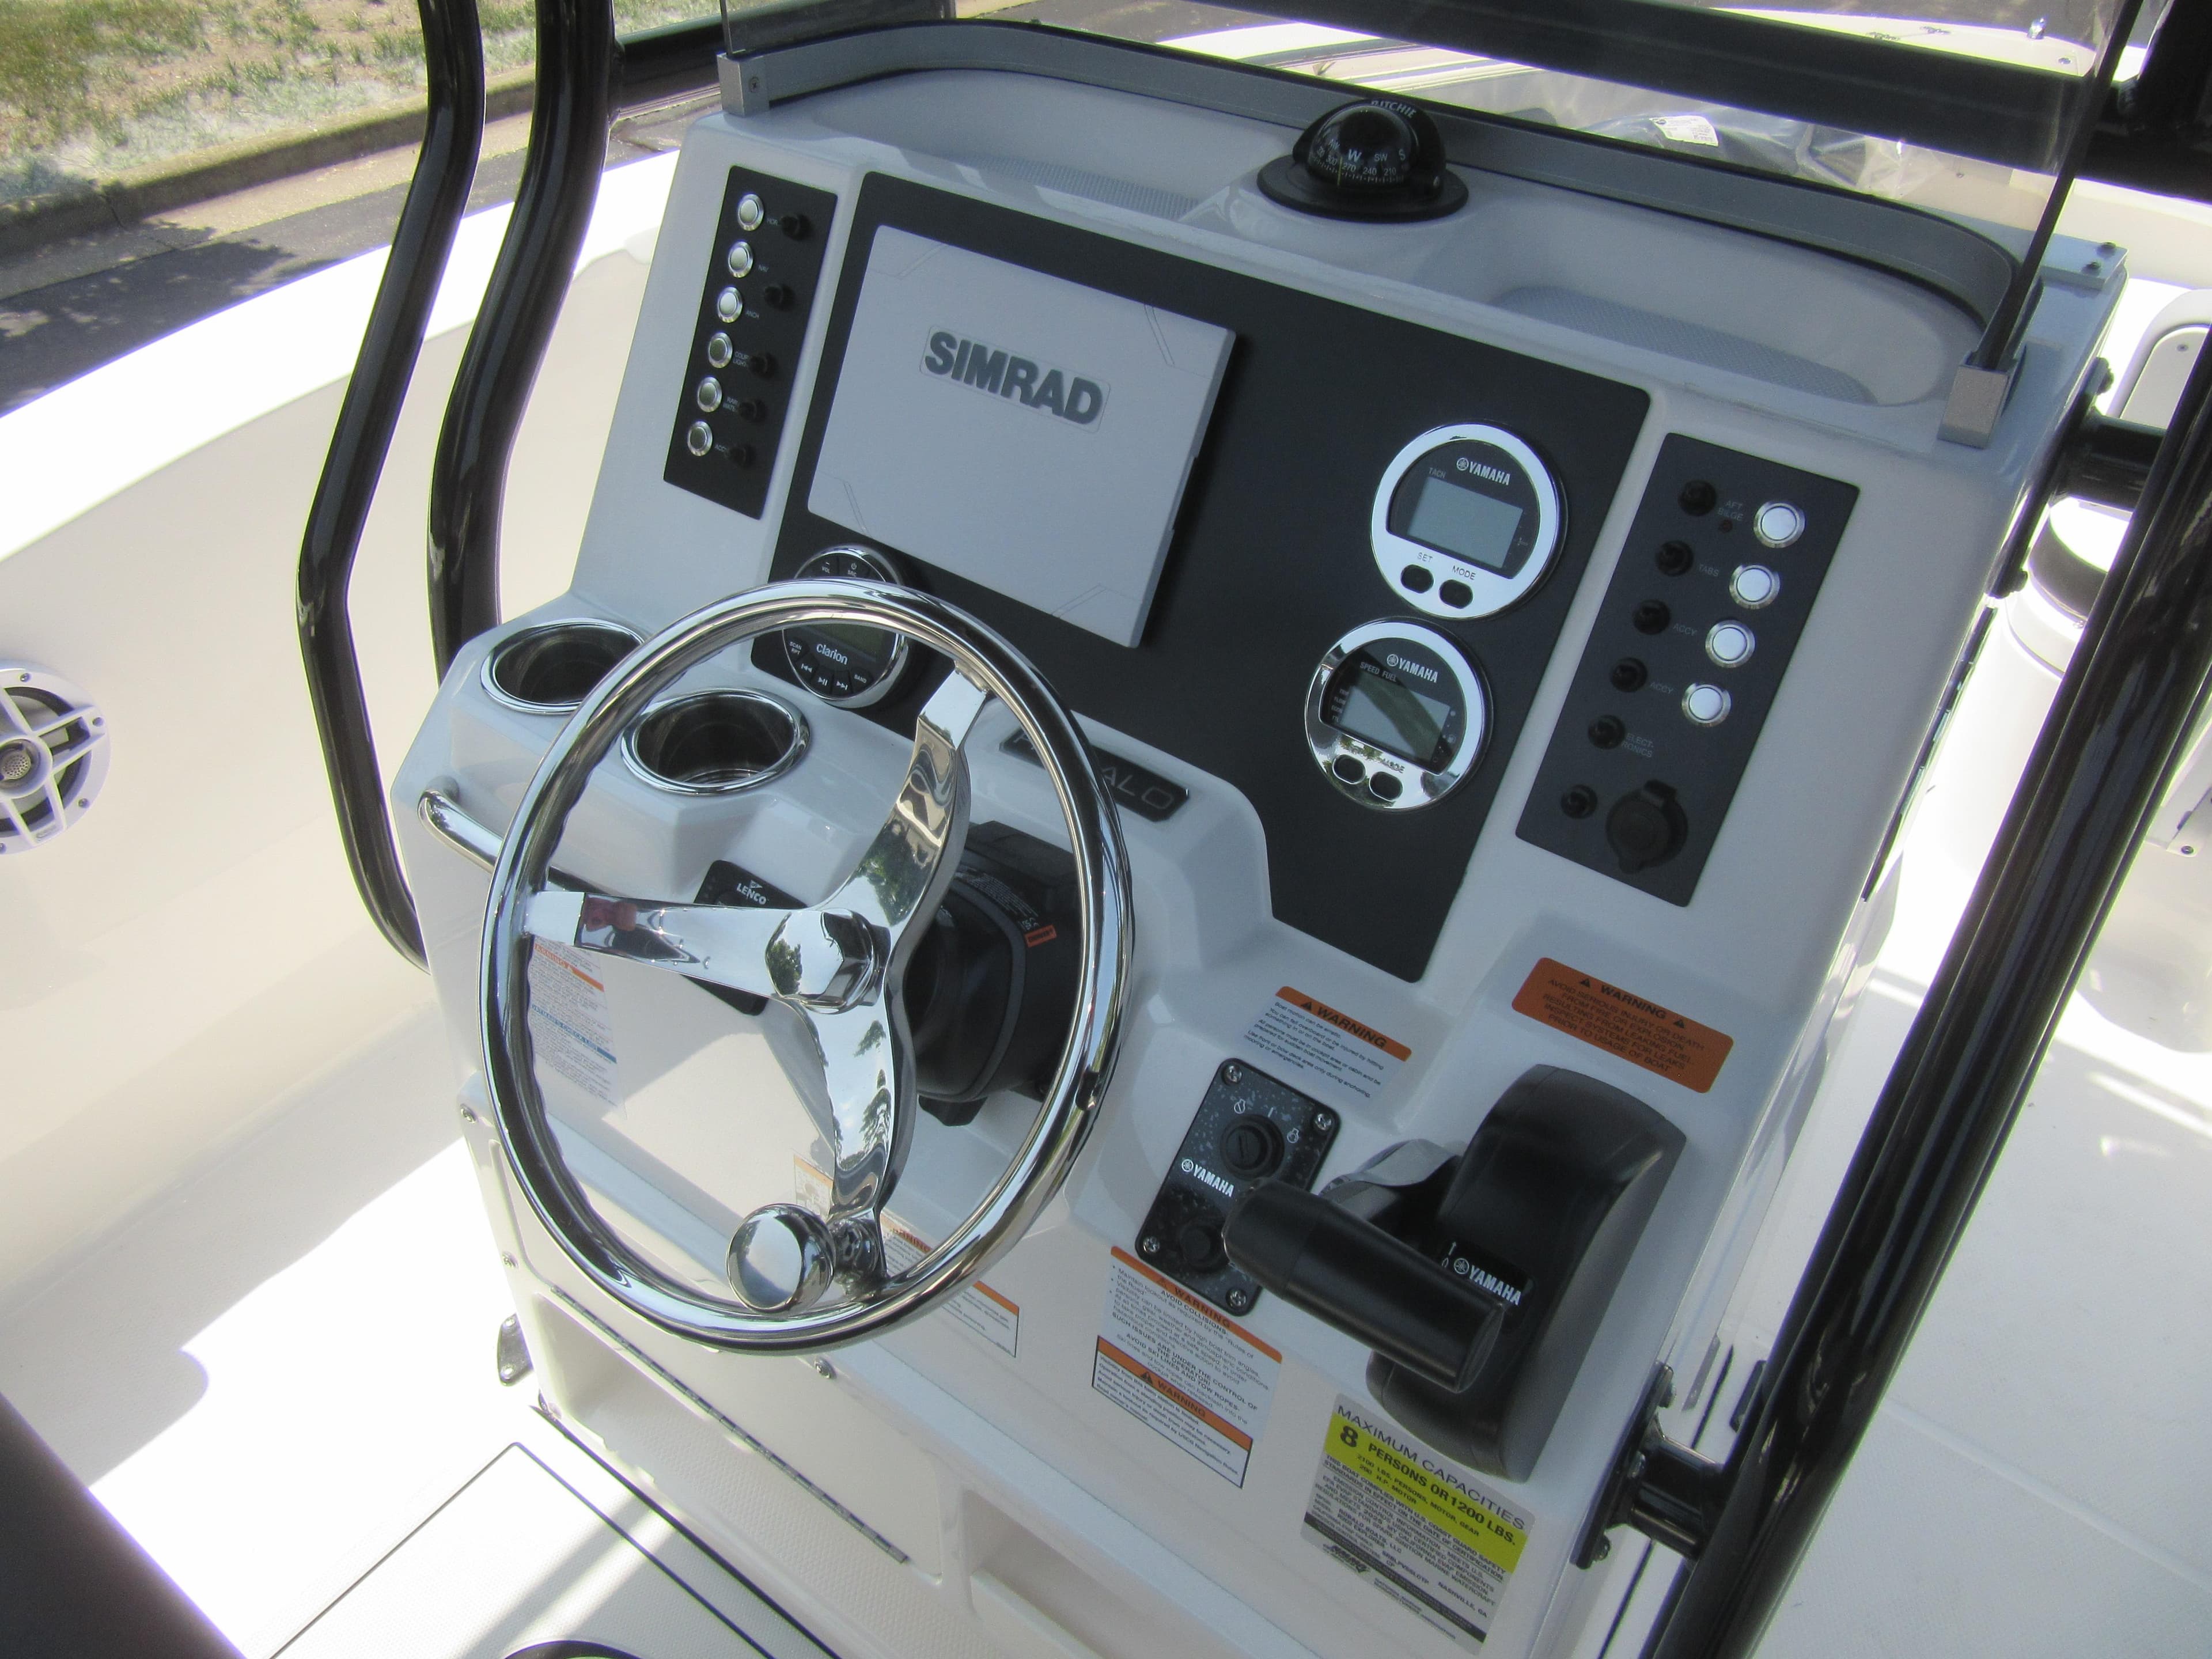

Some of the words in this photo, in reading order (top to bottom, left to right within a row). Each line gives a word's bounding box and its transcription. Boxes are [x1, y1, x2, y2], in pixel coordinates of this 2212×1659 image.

[1342, 162, 1356, 172] 270
[1363, 167, 1377, 176] 240
[1384, 168, 1397, 176] 210
[1348, 149, 1362, 162] W
[1399, 149, 1406, 161] S
[925, 331, 1103, 425] SIMRAD
[1429, 467, 1446, 478] TACH
[1468, 461, 1511, 486] YAMAHA
[1417, 552, 1434, 563] SET
[1452, 565, 1476, 581] MODE
[816, 643, 849, 665] clarion
[1360, 662, 1380, 675] SPEED
[1382, 670, 1398, 683] FUEL
[1398, 657, 1439, 684] YAMAHA
[736, 882, 767, 905] LENCO
[1598, 984, 1668, 1020] WARNING
[1315, 1006, 1389, 1048] WARNING
[1193, 1164, 1235, 1198] YAMAHA
[1161, 1288, 1182, 1307] AVOID
[1469, 1264, 1522, 1306] YAMAHA
[1174, 1286, 1230, 1329] WARNING
[1157, 1380, 1206, 1418] WARNING
[1212, 1377, 1247, 1405] CONTROL
[1337, 1403, 1418, 1463] MAXIMUM
[1421, 1457, 1525, 1531] CAPACITIES
[1339, 1422, 1361, 1450] 8
[1367, 1441, 1428, 1488] PERSONS
[1429, 1482, 1449, 1502] OR
[1449, 1494, 1486, 1525] 1200
[1486, 1518, 1518, 1546] LBS.
[1357, 1453, 1374, 1468] 2100
[1459, 1520, 1480, 1537] GEAR
[1391, 1484, 1417, 1505] MOTOR
